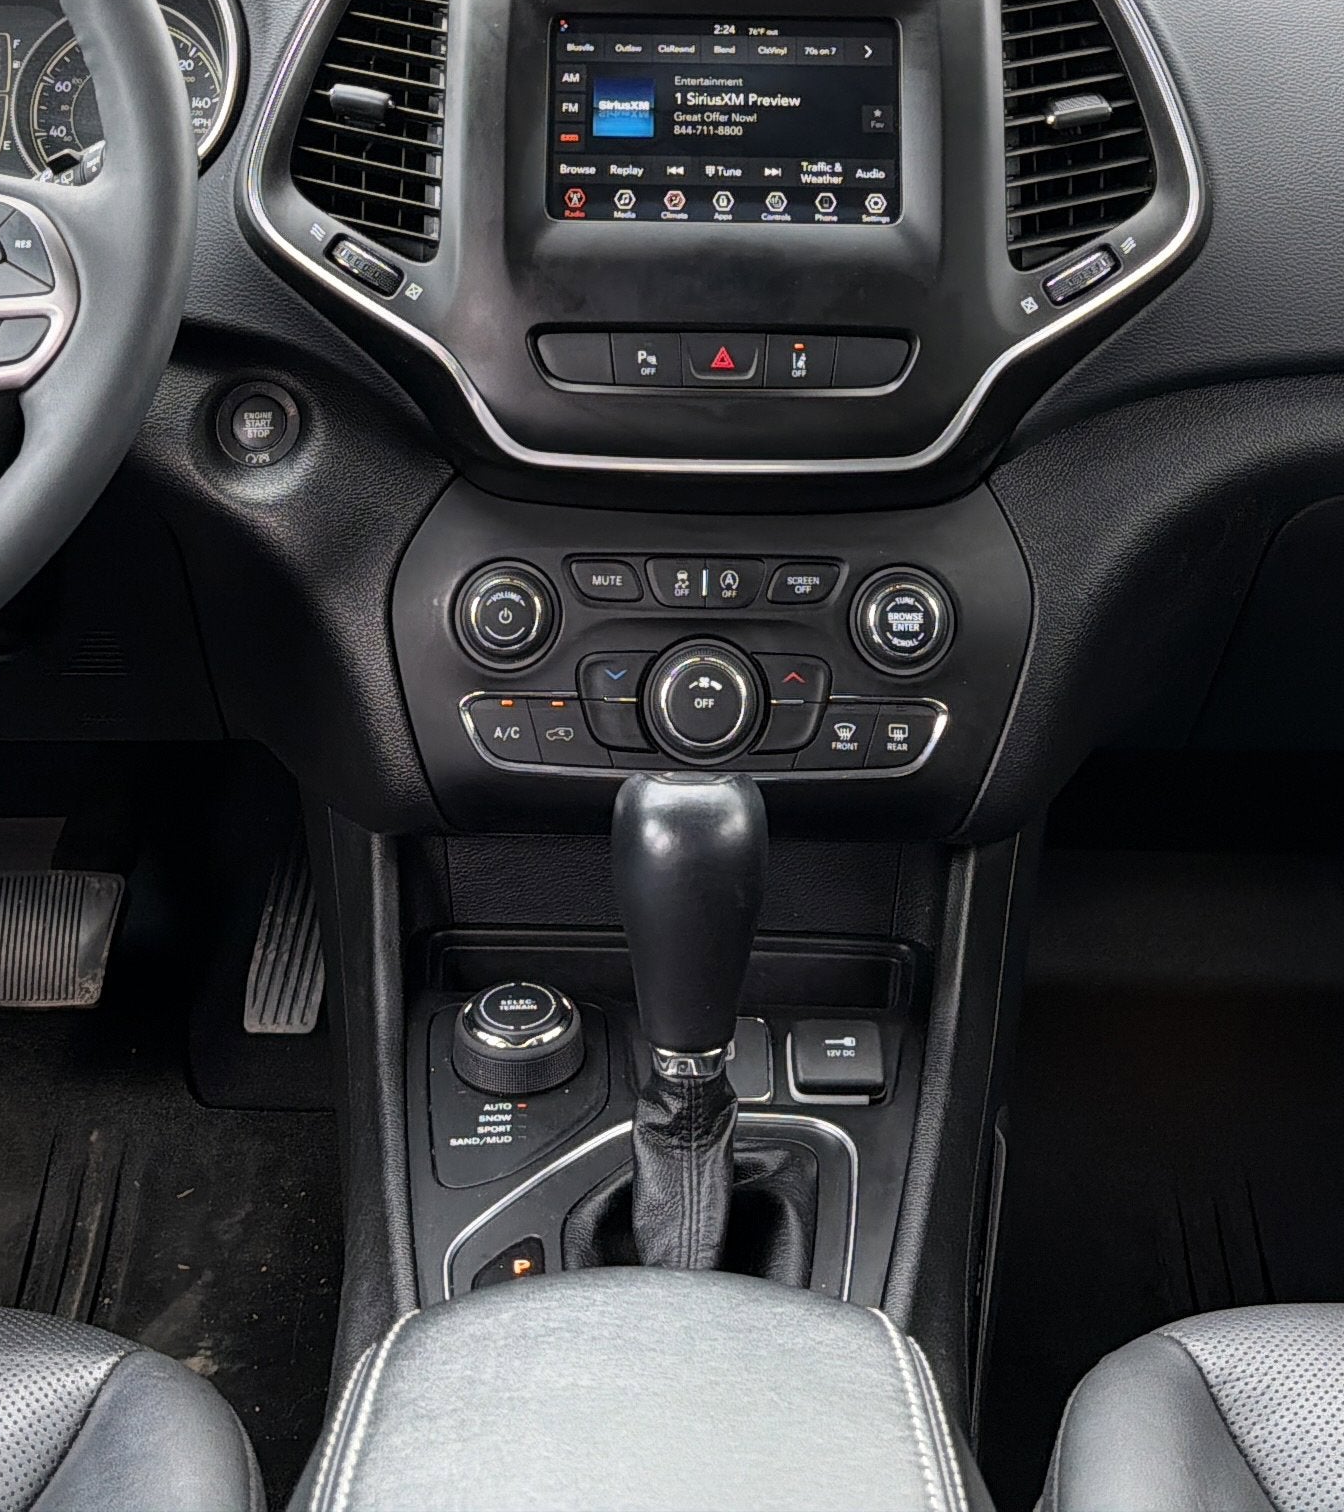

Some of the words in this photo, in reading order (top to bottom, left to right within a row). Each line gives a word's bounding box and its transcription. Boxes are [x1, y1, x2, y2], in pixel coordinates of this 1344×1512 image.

[713, 24, 737, 35] 2:24
[13, 39, 21, 49] F
[819, 48, 830, 56] on
[831, 47, 837, 56] 7
[561, 72, 580, 83] AM
[674, 75, 743, 87] Entertainment
[54, 80, 72, 93] 60
[191, 96, 211, 110] 140
[674, 92, 682, 105] 1
[686, 92, 745, 106] SiriusXM
[748, 93, 801, 107] Preview
[561, 102, 579, 113] FM
[674, 111, 702, 122] Great
[703, 111, 729, 122] Offer
[731, 112, 758, 123] Now!
[870, 120, 885, 129] Fav
[49, 124, 67, 138] 40
[674, 125, 743, 136] 844-711-8800
[3, 140, 12, 150] E
[559, 163, 597, 175] Browse
[609, 164, 645, 178] Replay
[717, 166, 742, 177] Tune
[800, 161, 832, 173] Traffic
[834, 162, 843, 173] &
[855, 168, 886, 179] Audio
[800, 173, 844, 185] Weather
[564, 210, 586, 218] Radio
[613, 210, 636, 219] Media
[660, 211, 689, 220] Climate
[713, 212, 733, 221] Apps
[761, 212, 792, 221] Controls
[814, 213, 838, 222] Phone
[862, 214, 891, 224] Settings
[14, 239, 32, 249] RES
[640, 367, 656, 376] OFF
[791, 369, 806, 378] OFF
[243, 411, 273, 420] ENGINE
[245, 419, 271, 428] START
[247, 429, 270, 438] STOP
[591, 575, 623, 586] MUTE
[786, 576, 820, 586] SCREEN
[674, 588, 690, 597] OFF
[721, 590, 737, 599] OFF
[794, 585, 812, 595] OFF
[490, 591, 522, 603] VOLUME
[895, 596, 916, 606] TUNE
[887, 612, 924, 621] BROWSE
[892, 623, 920, 632] ENTER
[891, 637, 920, 648] SCROLL
[694, 698, 715, 709] OFF
[493, 726, 521, 741] A/C
[831, 741, 859, 751] FRONT
[887, 742, 908, 752] REAR
[499, 1004, 538, 1012] TERRAIN
[826, 1049, 842, 1057] 12V
[842, 1049, 855, 1057] DC
[483, 1102, 513, 1111] AUTO
[478, 1114, 513, 1123] SNOW
[477, 1124, 513, 1134] SPORT
[449, 1135, 513, 1147] SAND/MUD
[513, 1259, 531, 1274] P
